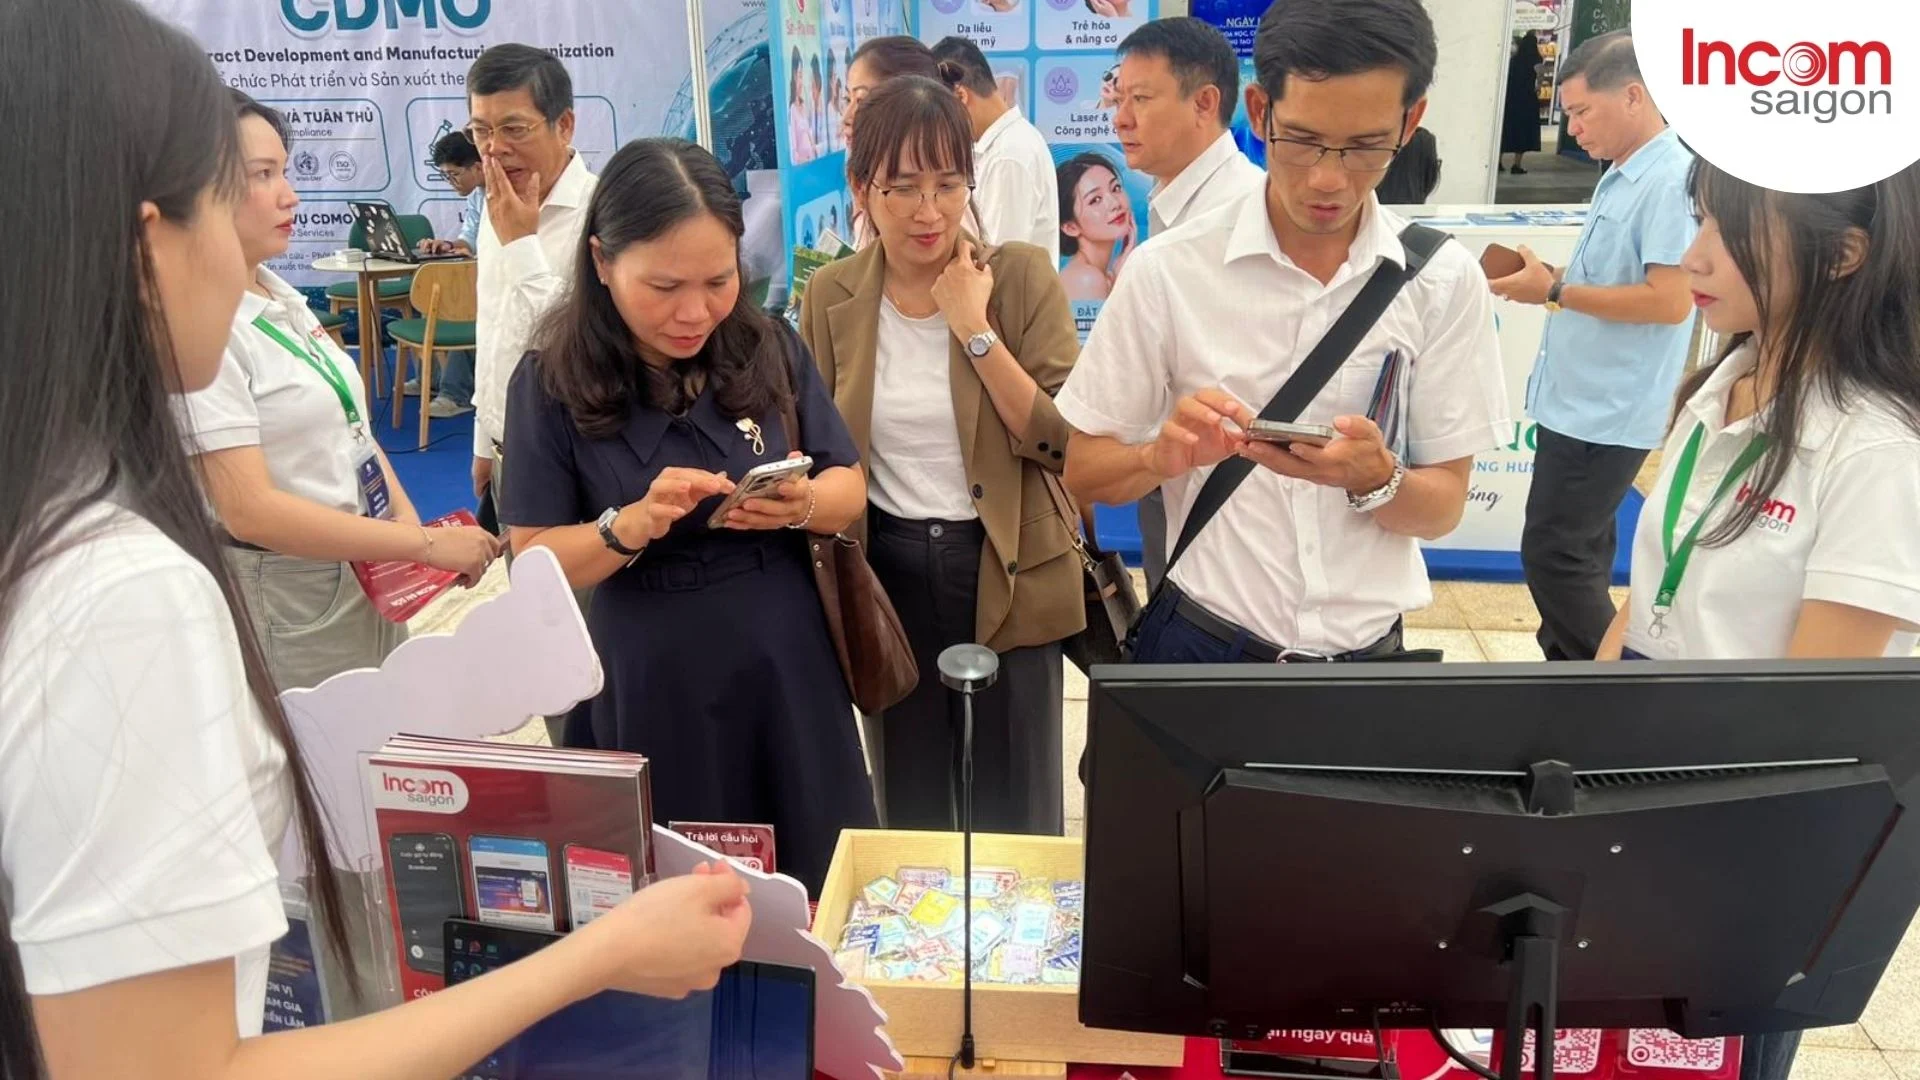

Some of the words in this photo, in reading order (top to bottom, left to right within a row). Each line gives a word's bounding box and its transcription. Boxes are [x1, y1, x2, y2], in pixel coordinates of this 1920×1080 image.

[957, 23, 971, 34] Da
[973, 21, 992, 34] liễu
[1072, 20, 1089, 31] Trẻ
[1092, 20, 1110, 31] hóa
[1065, 34, 1073, 44] &
[1104, 34, 1118, 43] cơ
[207, 50, 242, 63] ract
[244, 48, 350, 65] Development
[353, 47, 383, 61] and
[386, 45, 485, 61] Manufacturi
[549, 43, 615, 59] nization
[230, 72, 268, 89] chức
[271, 71, 307, 88] Phát
[310, 69, 346, 87] triển
[350, 71, 368, 87] và
[371, 70, 401, 87] Sản
[403, 68, 438, 86] xuất
[440, 70, 465, 86] the
[303, 108, 343, 123] TUÂN
[345, 106, 374, 123] THỦ
[1070, 113, 1098, 123] Laser
[1102, 113, 1109, 122] &
[1054, 125, 1081, 137] Công
[1084, 125, 1110, 137] nghệ
[310, 213, 354, 225] CDMO
[1467, 484, 1503, 512] ống
[1735, 481, 1796, 523] Inom
[1757, 515, 1790, 533] gon
[383, 772, 454, 796] Incom
[407, 793, 456, 807] saigon
[1291, 1029, 1335, 1043] ngay
[1340, 1030, 1374, 1045] quà
